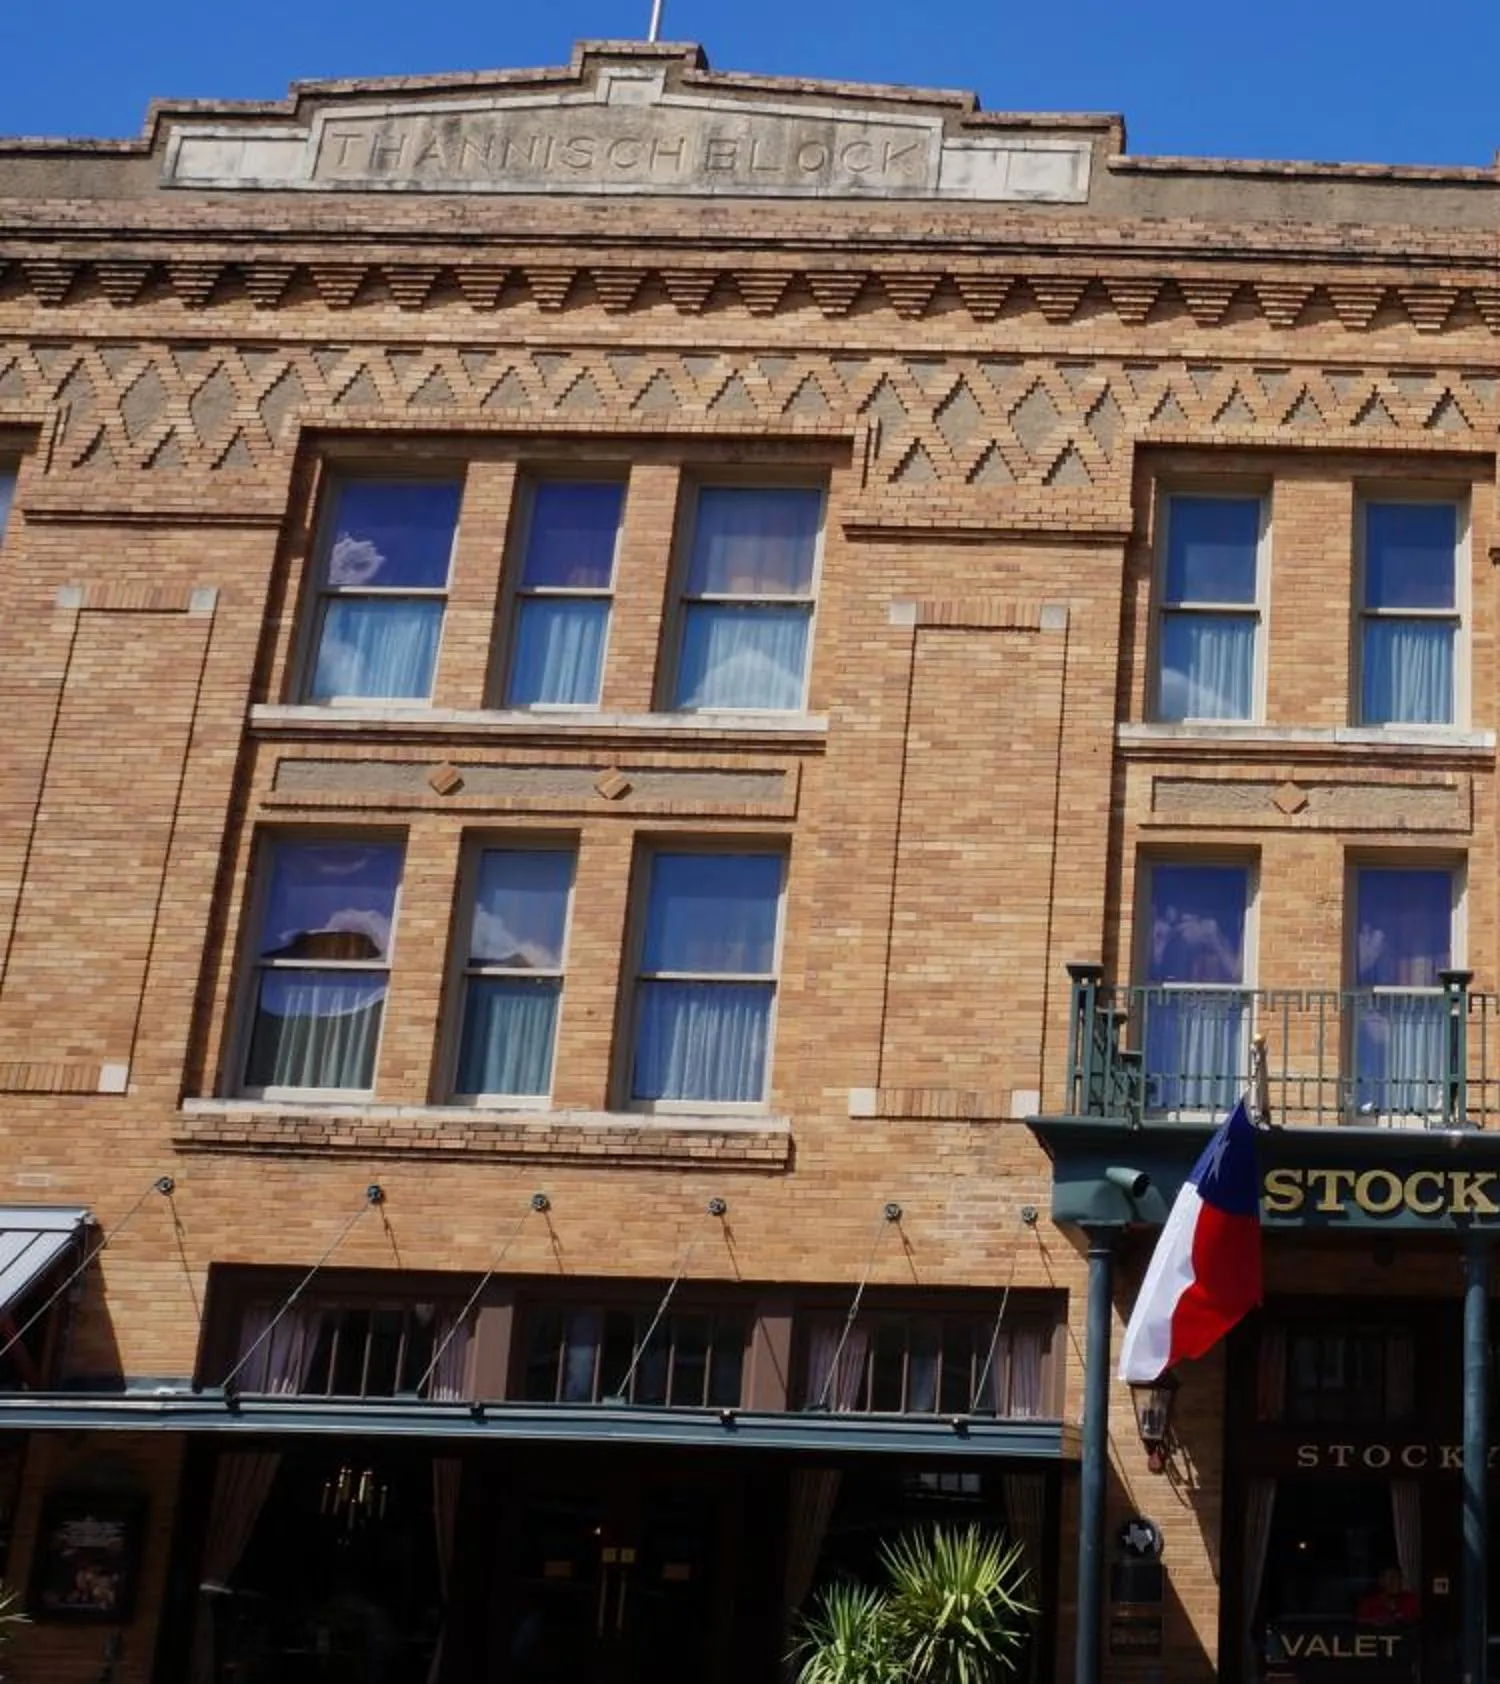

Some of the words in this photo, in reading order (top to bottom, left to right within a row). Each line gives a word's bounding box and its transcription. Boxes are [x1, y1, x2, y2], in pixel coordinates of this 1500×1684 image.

[330, 130, 686, 173] THANNISCH
[703, 137, 920, 175] BLOCK
[1280, 1633, 1403, 1658] VALET
